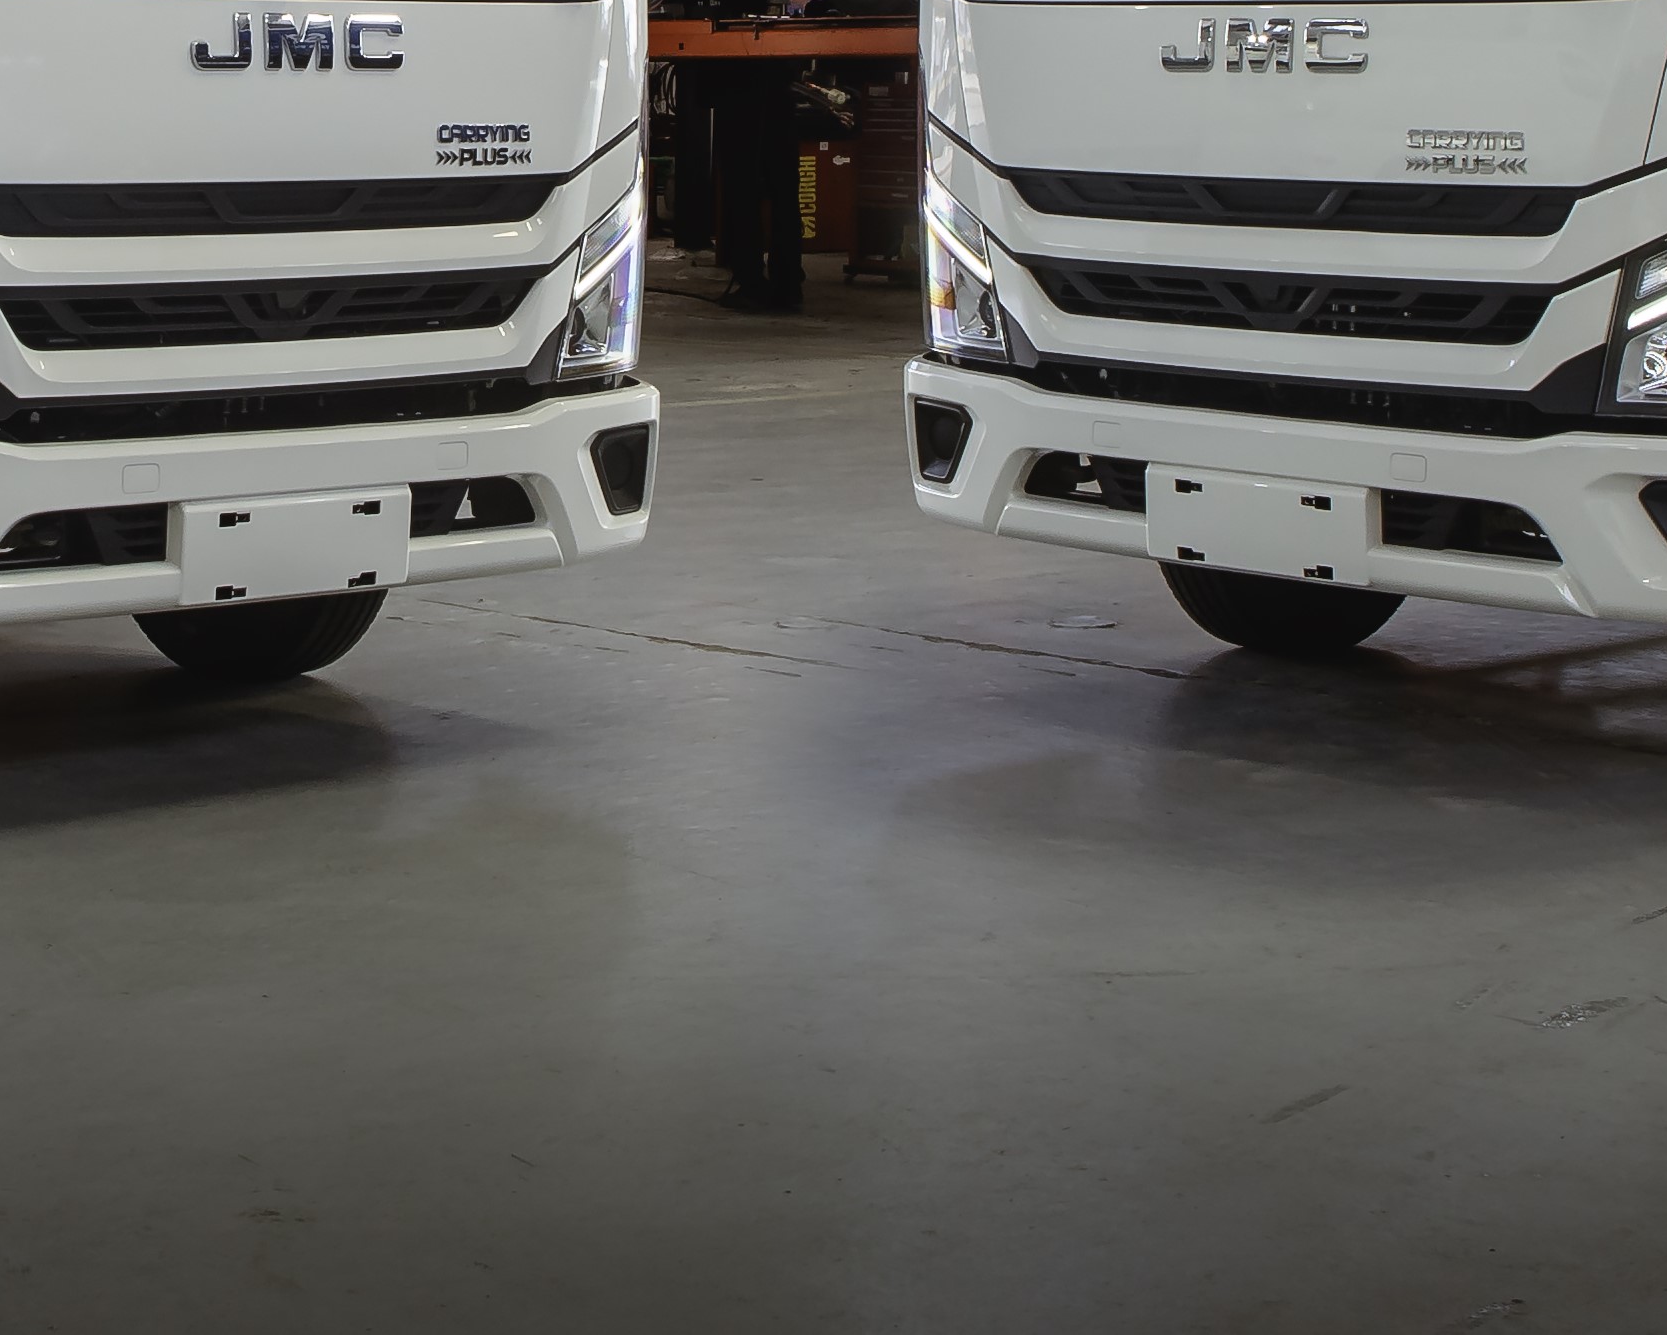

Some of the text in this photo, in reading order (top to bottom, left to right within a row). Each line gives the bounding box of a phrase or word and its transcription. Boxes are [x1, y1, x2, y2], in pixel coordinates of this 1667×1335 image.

[190, 12, 406, 71] JMC
[1159, 17, 1369, 73] JMC
[437, 124, 530, 143] CARRYING
[1406, 129, 1525, 151] CARRYING
[459, 147, 509, 166] PLUS
[1432, 154, 1496, 175] PLUS
[798, 155, 817, 214] CORGHI
